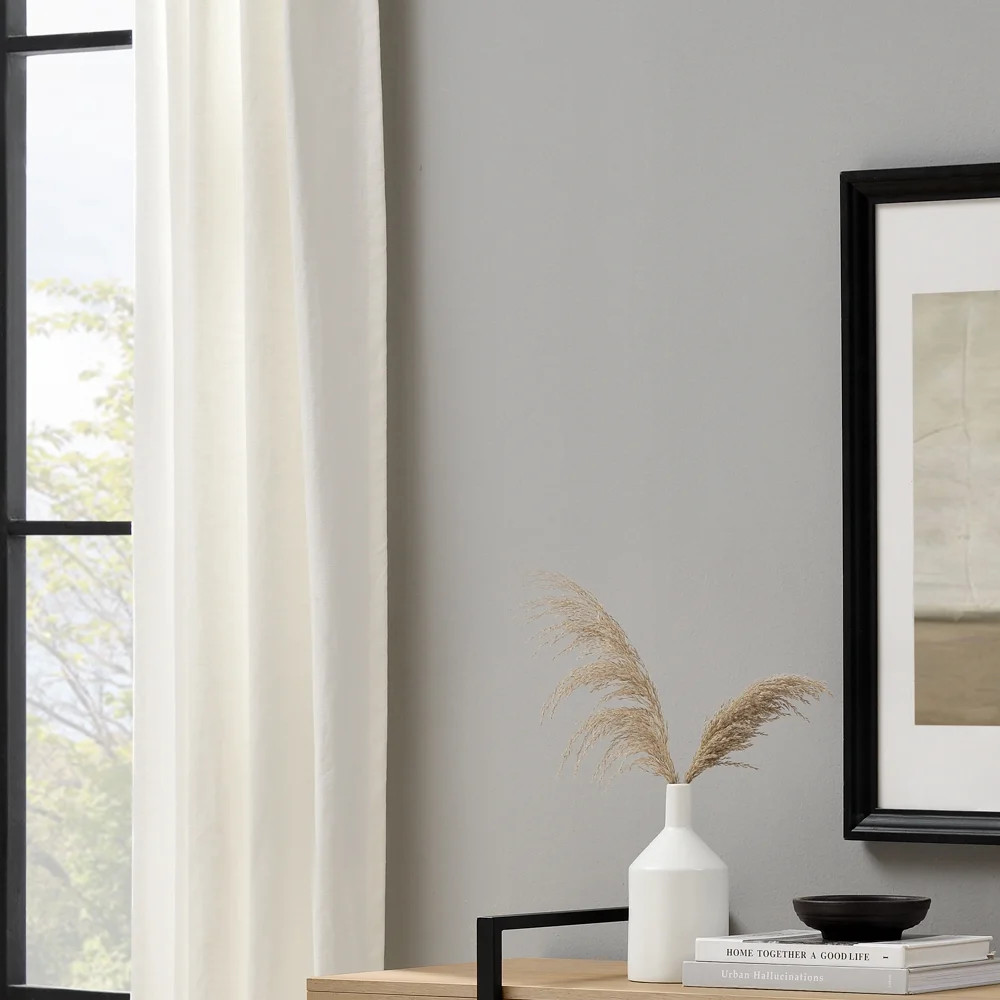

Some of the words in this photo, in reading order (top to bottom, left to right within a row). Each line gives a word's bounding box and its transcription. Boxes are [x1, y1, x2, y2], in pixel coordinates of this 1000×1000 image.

[726, 948, 754, 958] HOME
[757, 949, 807, 959] TOGETHER
[810, 951, 817, 960] A
[820, 951, 847, 961] GOOD
[849, 952, 870, 961] LIFE
[721, 969, 750, 980] Urban
[753, 970, 824, 983] Hallucinations
